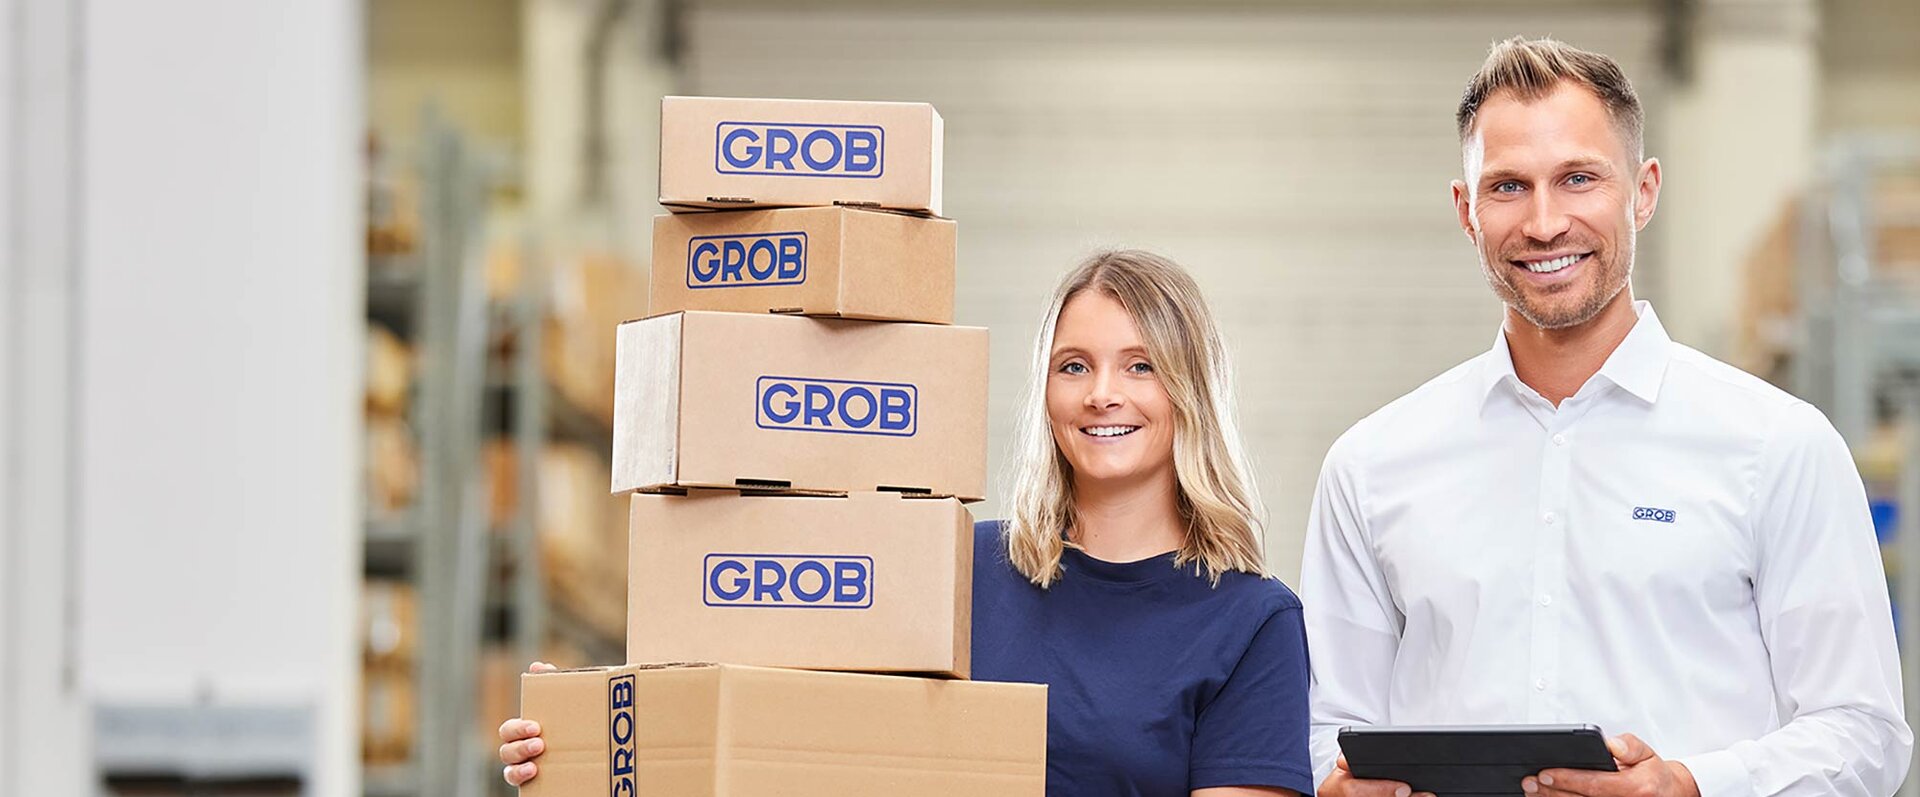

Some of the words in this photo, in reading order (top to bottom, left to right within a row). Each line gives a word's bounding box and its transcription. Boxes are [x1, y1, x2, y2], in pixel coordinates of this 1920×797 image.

[722, 128, 877, 172] GROB
[692, 238, 802, 282] GROB
[762, 382, 911, 429] GROB
[1634, 508, 1673, 521] GROB
[710, 560, 866, 602] GROB
